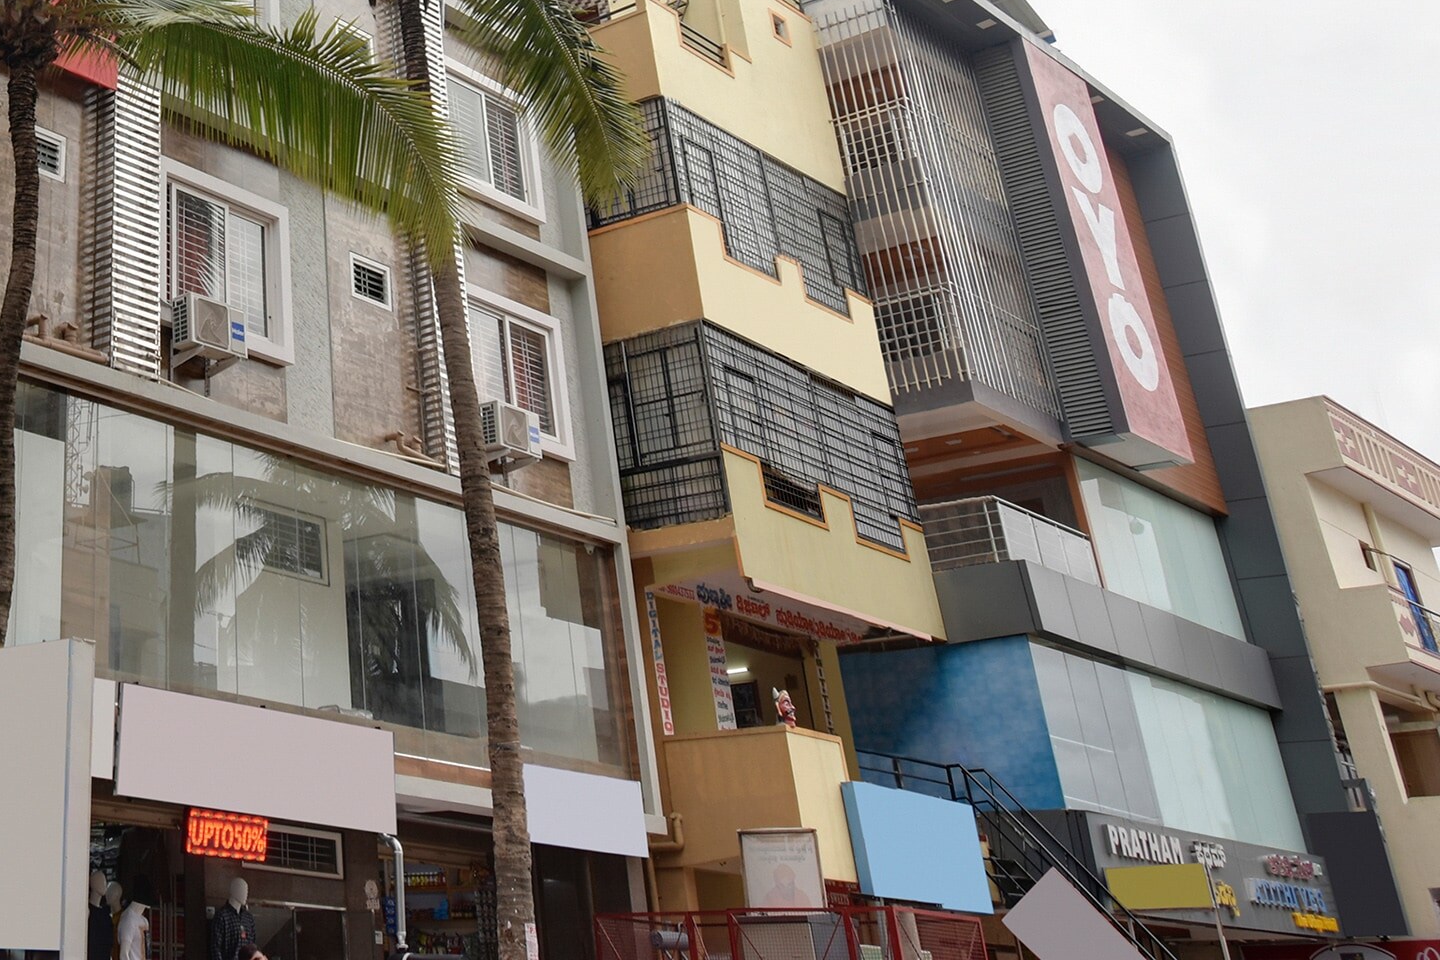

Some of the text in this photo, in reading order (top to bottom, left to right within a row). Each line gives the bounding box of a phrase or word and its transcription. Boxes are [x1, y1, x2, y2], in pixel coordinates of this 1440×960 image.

[1053, 103, 1160, 392] OYO
[646, 591, 674, 732] DIGITAL STUDIO
[1105, 823, 1185, 865] PRATHAM
